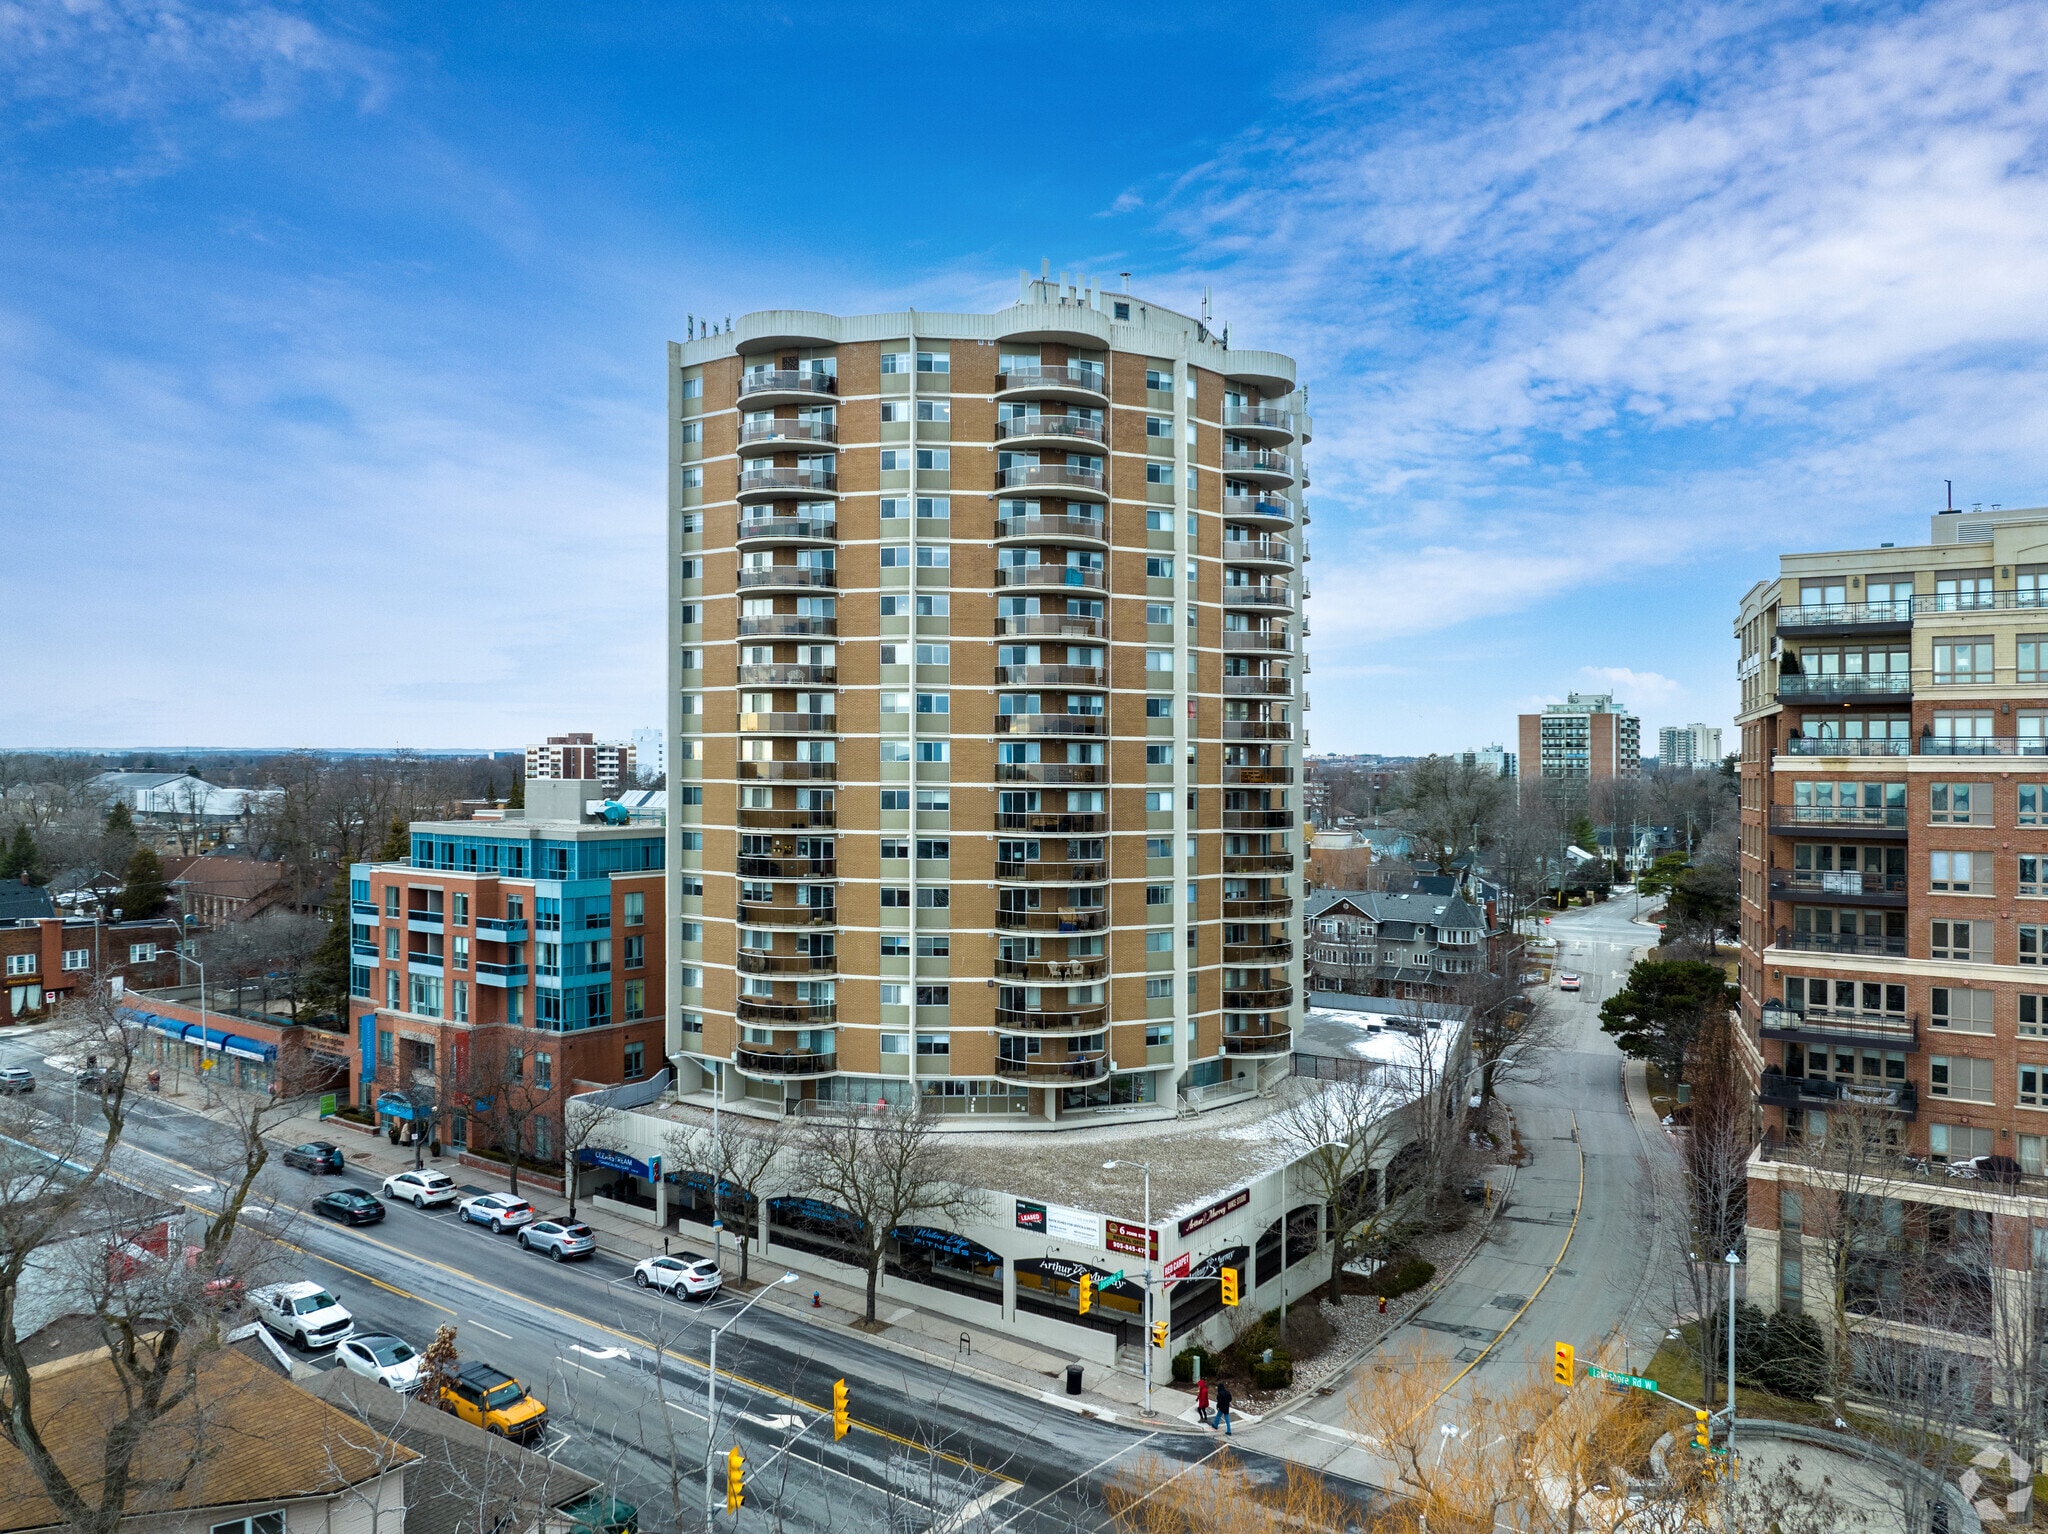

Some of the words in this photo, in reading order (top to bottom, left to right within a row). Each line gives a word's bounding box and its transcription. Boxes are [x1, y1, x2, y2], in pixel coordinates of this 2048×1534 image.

[1021, 1213, 1040, 1222] LEASED
[1186, 1217, 1204, 1232] Arthur
[1206, 1206, 1226, 1222] Murray
[914, 1227, 946, 1241] Waters
[946, 1234, 969, 1249] Edge
[1119, 1226, 1125, 1235] 6
[913, 1238, 970, 1257] FITNESS
[1113, 1235, 1132, 1244] RENTAL
[1132, 1239, 1147, 1247] OFFI
[1113, 1242, 1150, 1255] 905-845-47
[1039, 1260, 1073, 1275] Arthur
[1164, 1263, 1173, 1276] RED
[1173, 1255, 1189, 1271] CARPET
[1592, 1368, 1629, 1385] Lakeshore
[1632, 1377, 1642, 1388] Rd
[1645, 1380, 1652, 1390] W
